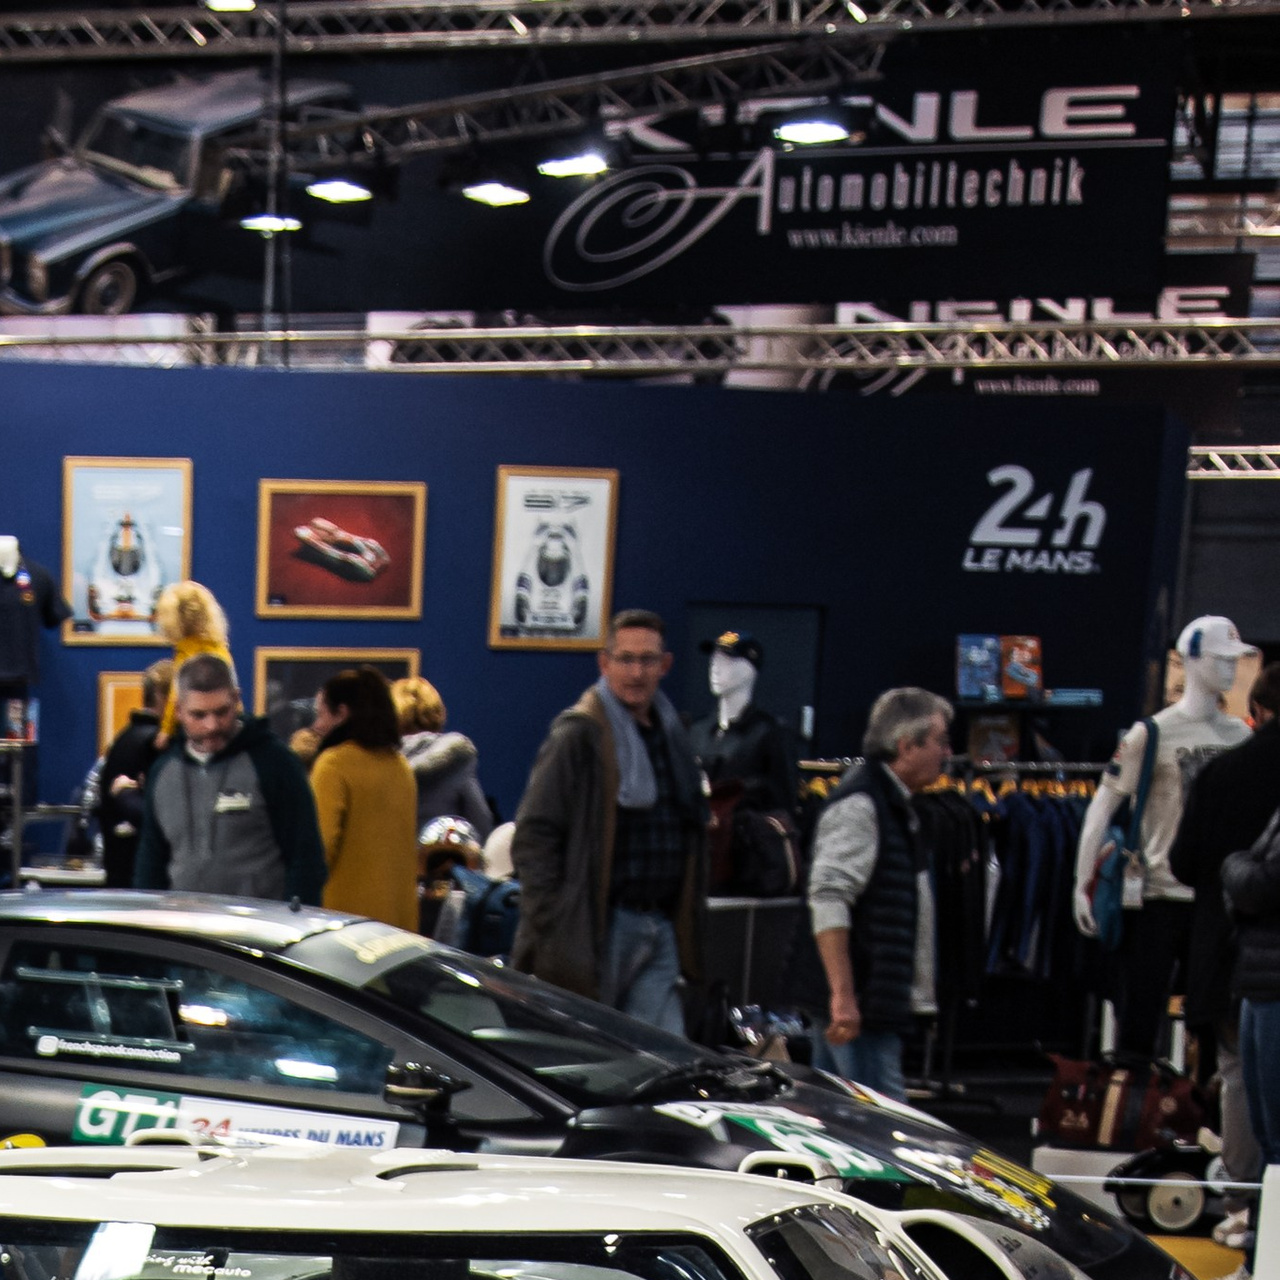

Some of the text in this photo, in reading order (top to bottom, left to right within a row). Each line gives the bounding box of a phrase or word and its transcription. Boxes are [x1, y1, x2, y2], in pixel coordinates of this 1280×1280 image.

[786, 220, 959, 249] www.kienle.com
[962, 548, 1095, 574] LE MANS
[335, 1130, 386, 1147] MANS
[172, 1264, 253, 1278] mecauto
